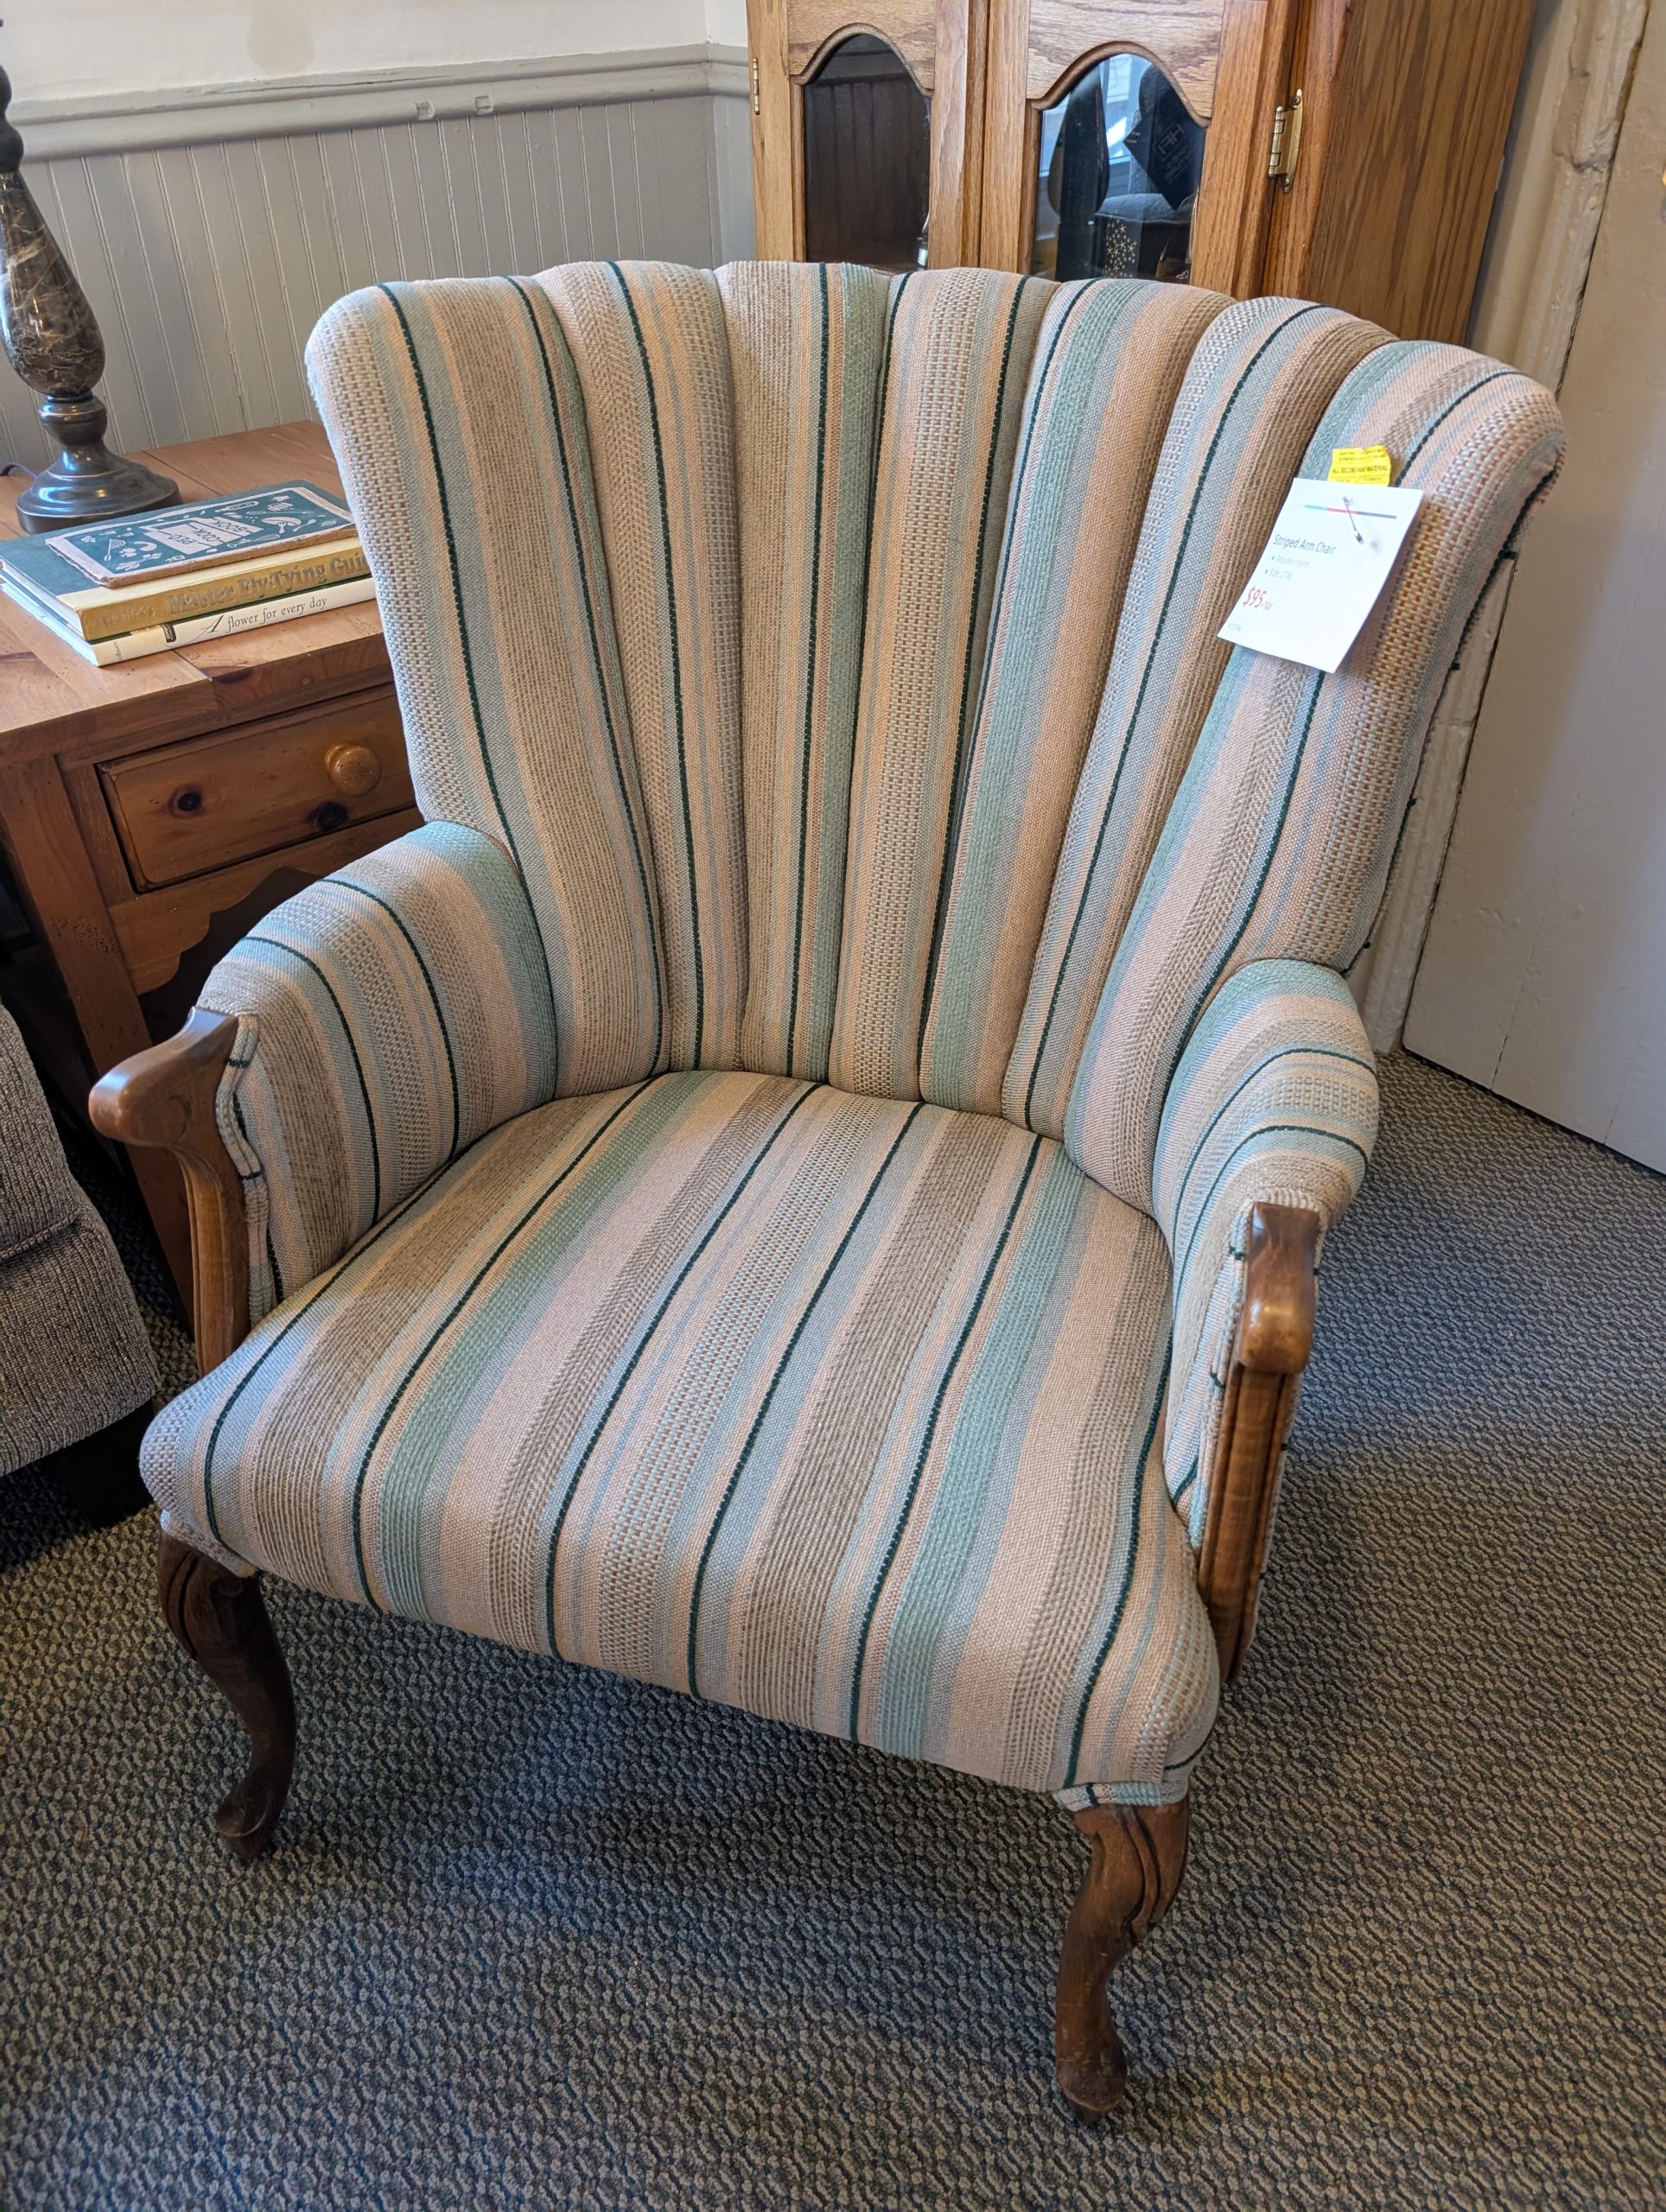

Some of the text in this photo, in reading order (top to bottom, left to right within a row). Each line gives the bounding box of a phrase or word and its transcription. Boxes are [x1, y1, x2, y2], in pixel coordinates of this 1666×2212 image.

[1273, 533, 1338, 555] Striped Arm Chair
[167, 583, 237, 615] Master
[226, 613, 258, 633] flower
[260, 608, 277, 625] for
[281, 601, 306, 616] every
[309, 595, 327, 611] day
